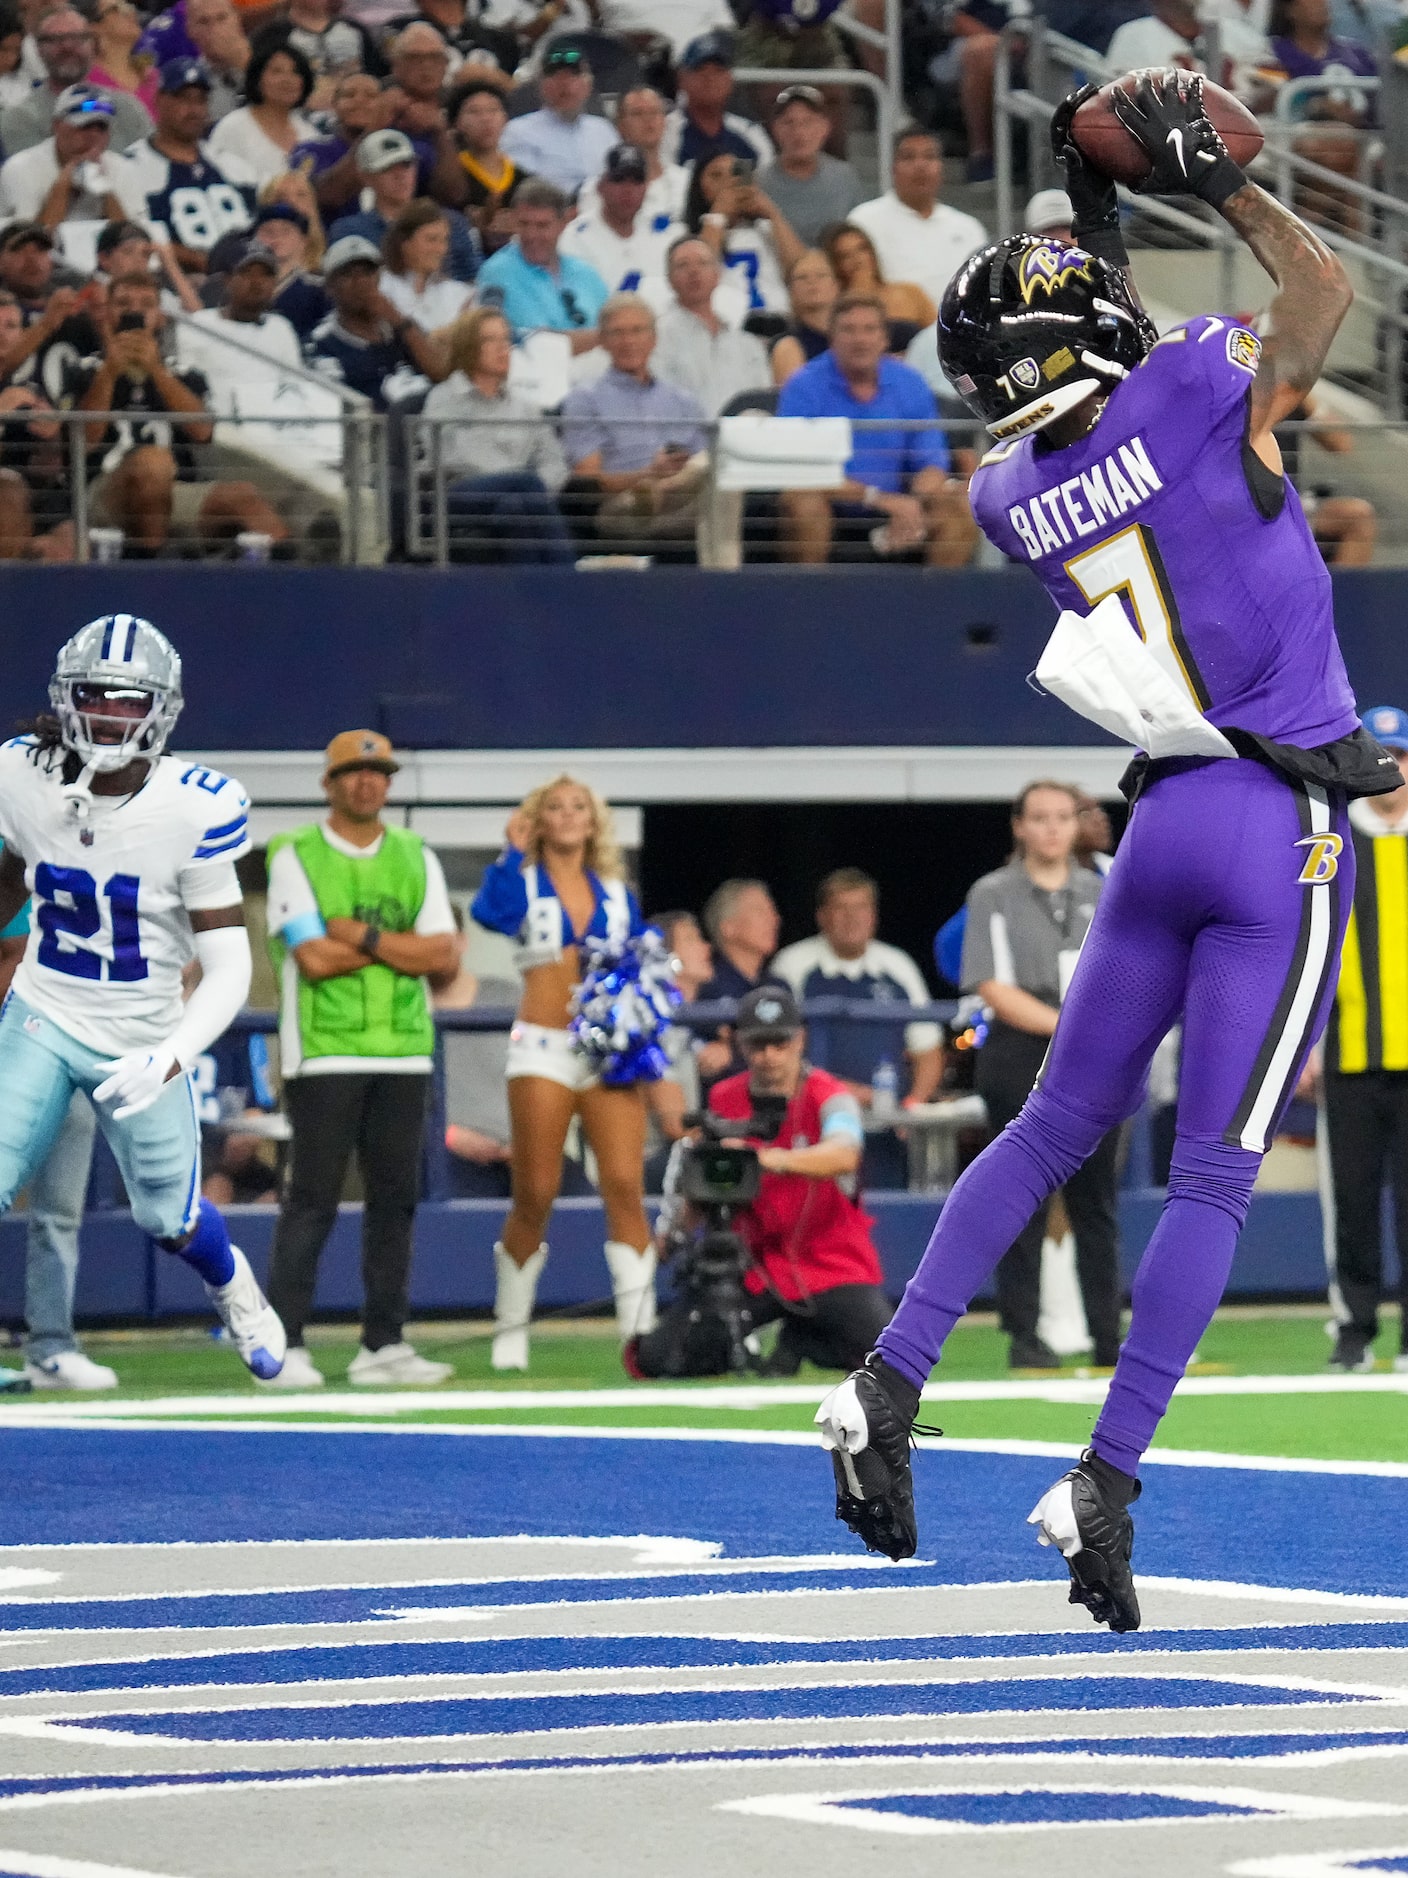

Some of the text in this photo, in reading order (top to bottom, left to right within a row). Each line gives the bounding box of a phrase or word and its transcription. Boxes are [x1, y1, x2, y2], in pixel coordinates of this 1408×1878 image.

[724, 252, 765, 309] 7
[995, 375, 1016, 400] 7
[1009, 436, 1163, 561] BATEMAN
[1062, 522, 1214, 714] 7
[1293, 832, 1344, 885] B
[35, 861, 149, 982] 21
